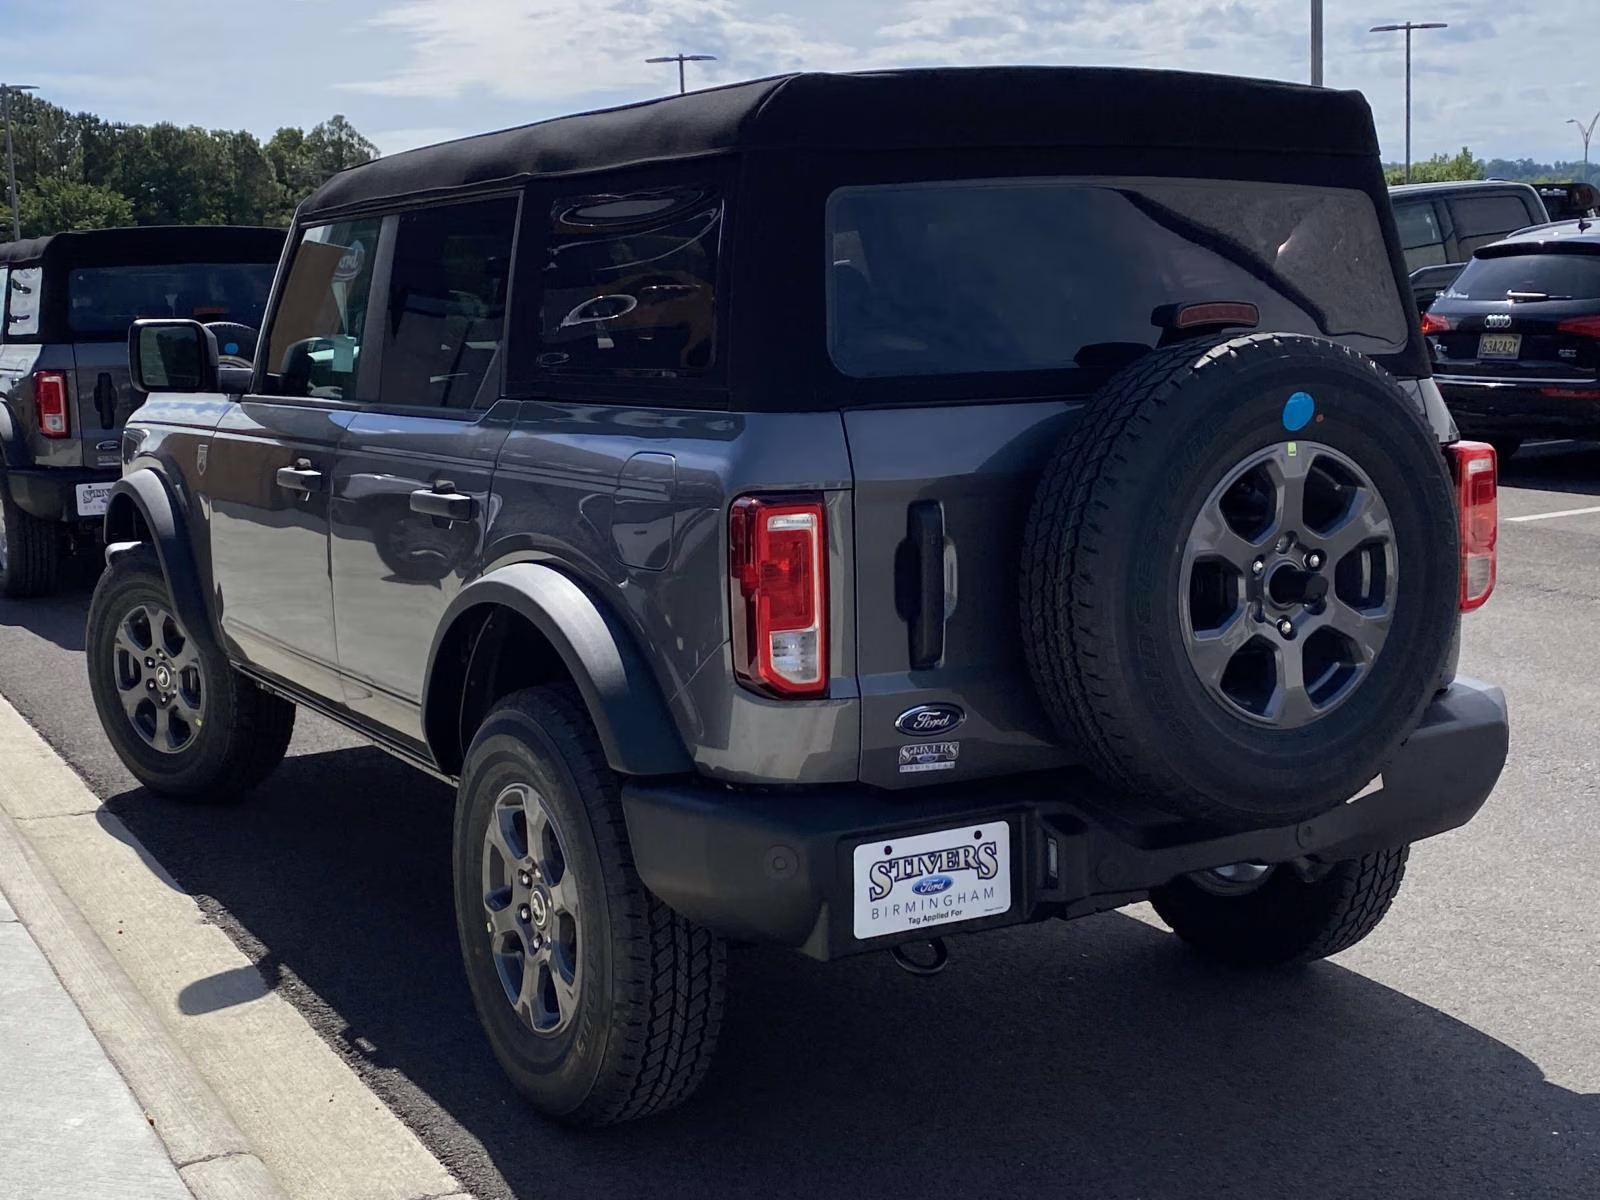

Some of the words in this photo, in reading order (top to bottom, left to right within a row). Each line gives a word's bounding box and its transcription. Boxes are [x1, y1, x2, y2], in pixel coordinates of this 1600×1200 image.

[913, 711, 950, 729] Ford
[869, 841, 998, 902] STIVERS
[871, 887, 994, 920] BIRMINGHAM
[908, 916, 921, 925] Tag
[922, 911, 949, 923] Applied
[951, 909, 963, 918] For
